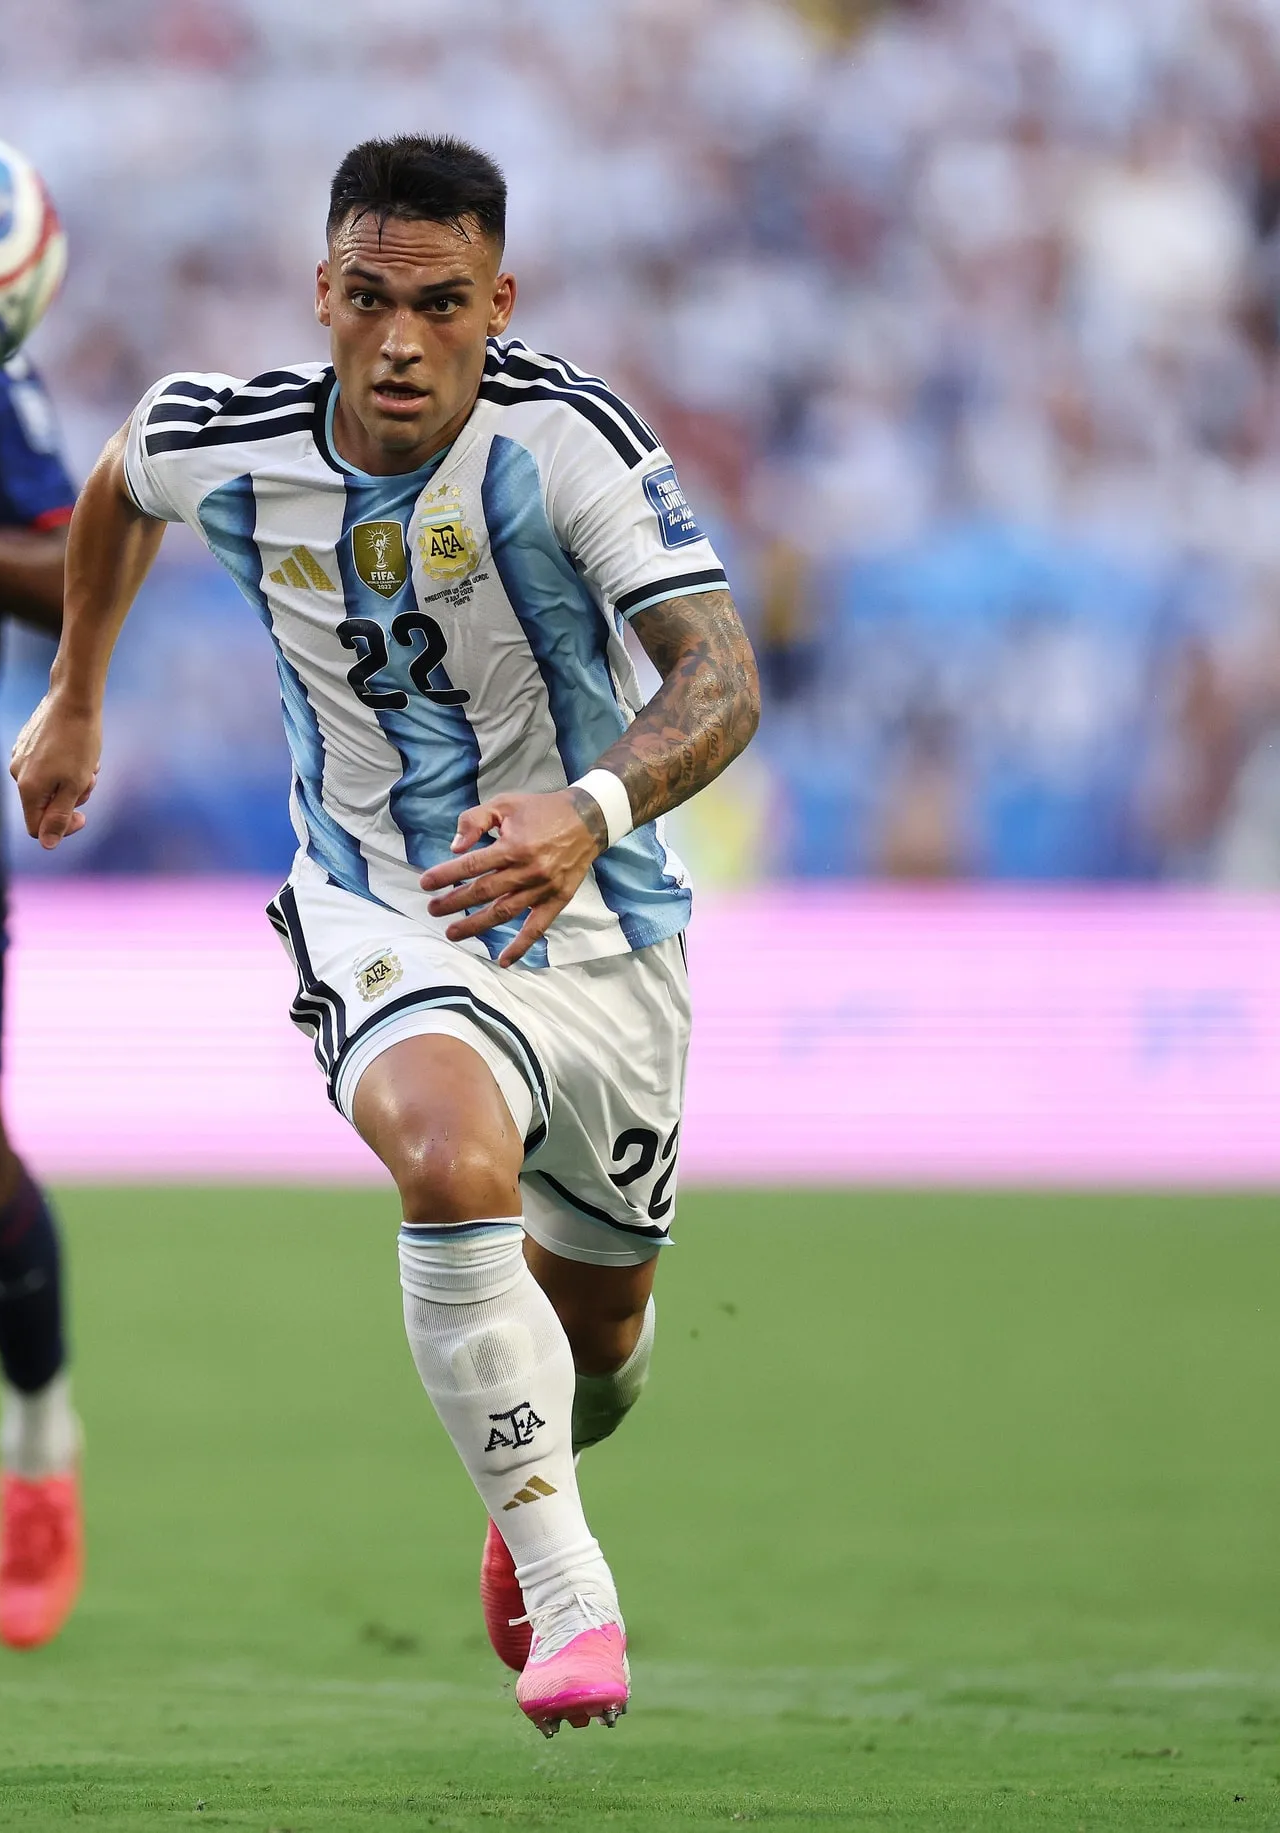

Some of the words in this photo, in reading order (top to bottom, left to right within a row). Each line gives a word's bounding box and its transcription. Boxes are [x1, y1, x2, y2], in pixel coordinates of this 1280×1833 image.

[430, 524, 465, 558] AFA
[681, 521, 697, 532] FIFA
[370, 571, 395, 581] FIFA
[335, 610, 471, 711] 22
[364, 960, 391, 988] AFA
[484, 1401, 546, 1453] AFA
